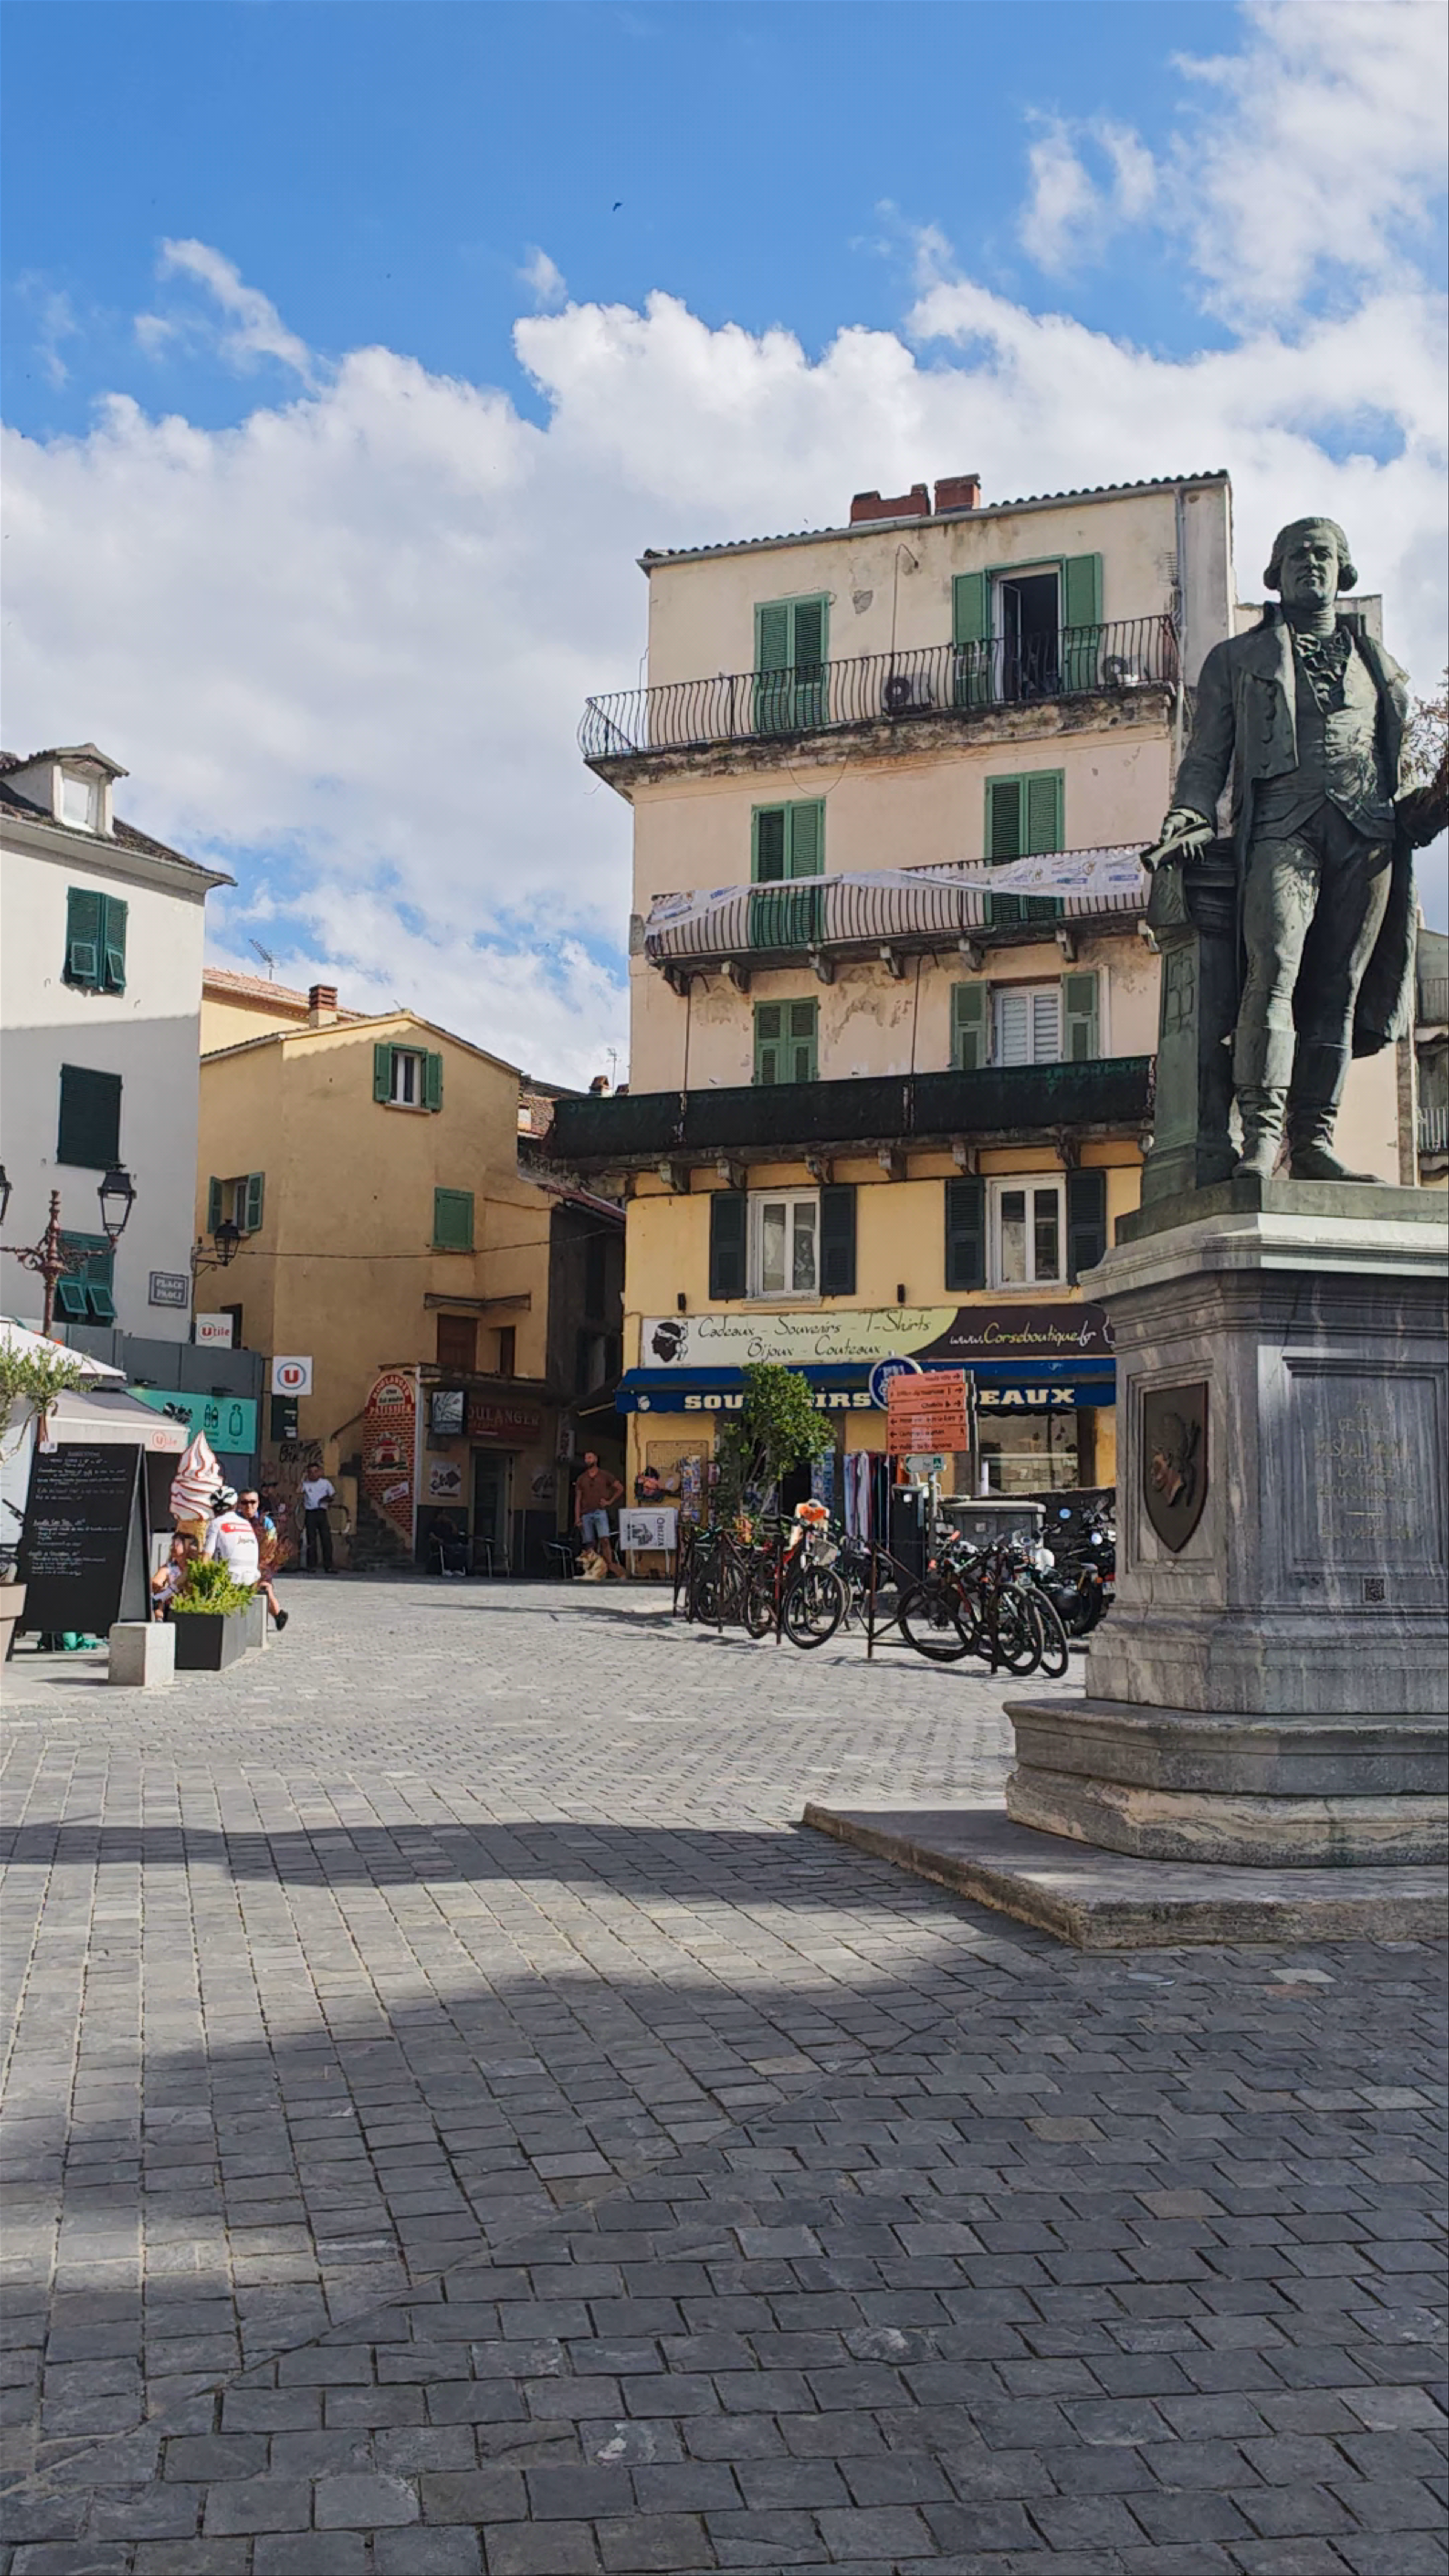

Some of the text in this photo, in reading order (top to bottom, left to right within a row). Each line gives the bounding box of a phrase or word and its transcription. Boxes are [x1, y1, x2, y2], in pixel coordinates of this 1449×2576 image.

[202, 1326, 230, 1336] Utile
[698, 1315, 754, 1338] Cadeaux
[774, 1315, 842, 1335] Souvenirs
[859, 1310, 931, 1332] T-Shirts
[747, 1336, 794, 1364] Bijoux
[815, 1334, 881, 1356] Couteaux
[284, 1370, 299, 1384] U
[684, 1389, 1074, 1409] SOUIRS EAUX
[468, 1405, 540, 1426] OULANGER
